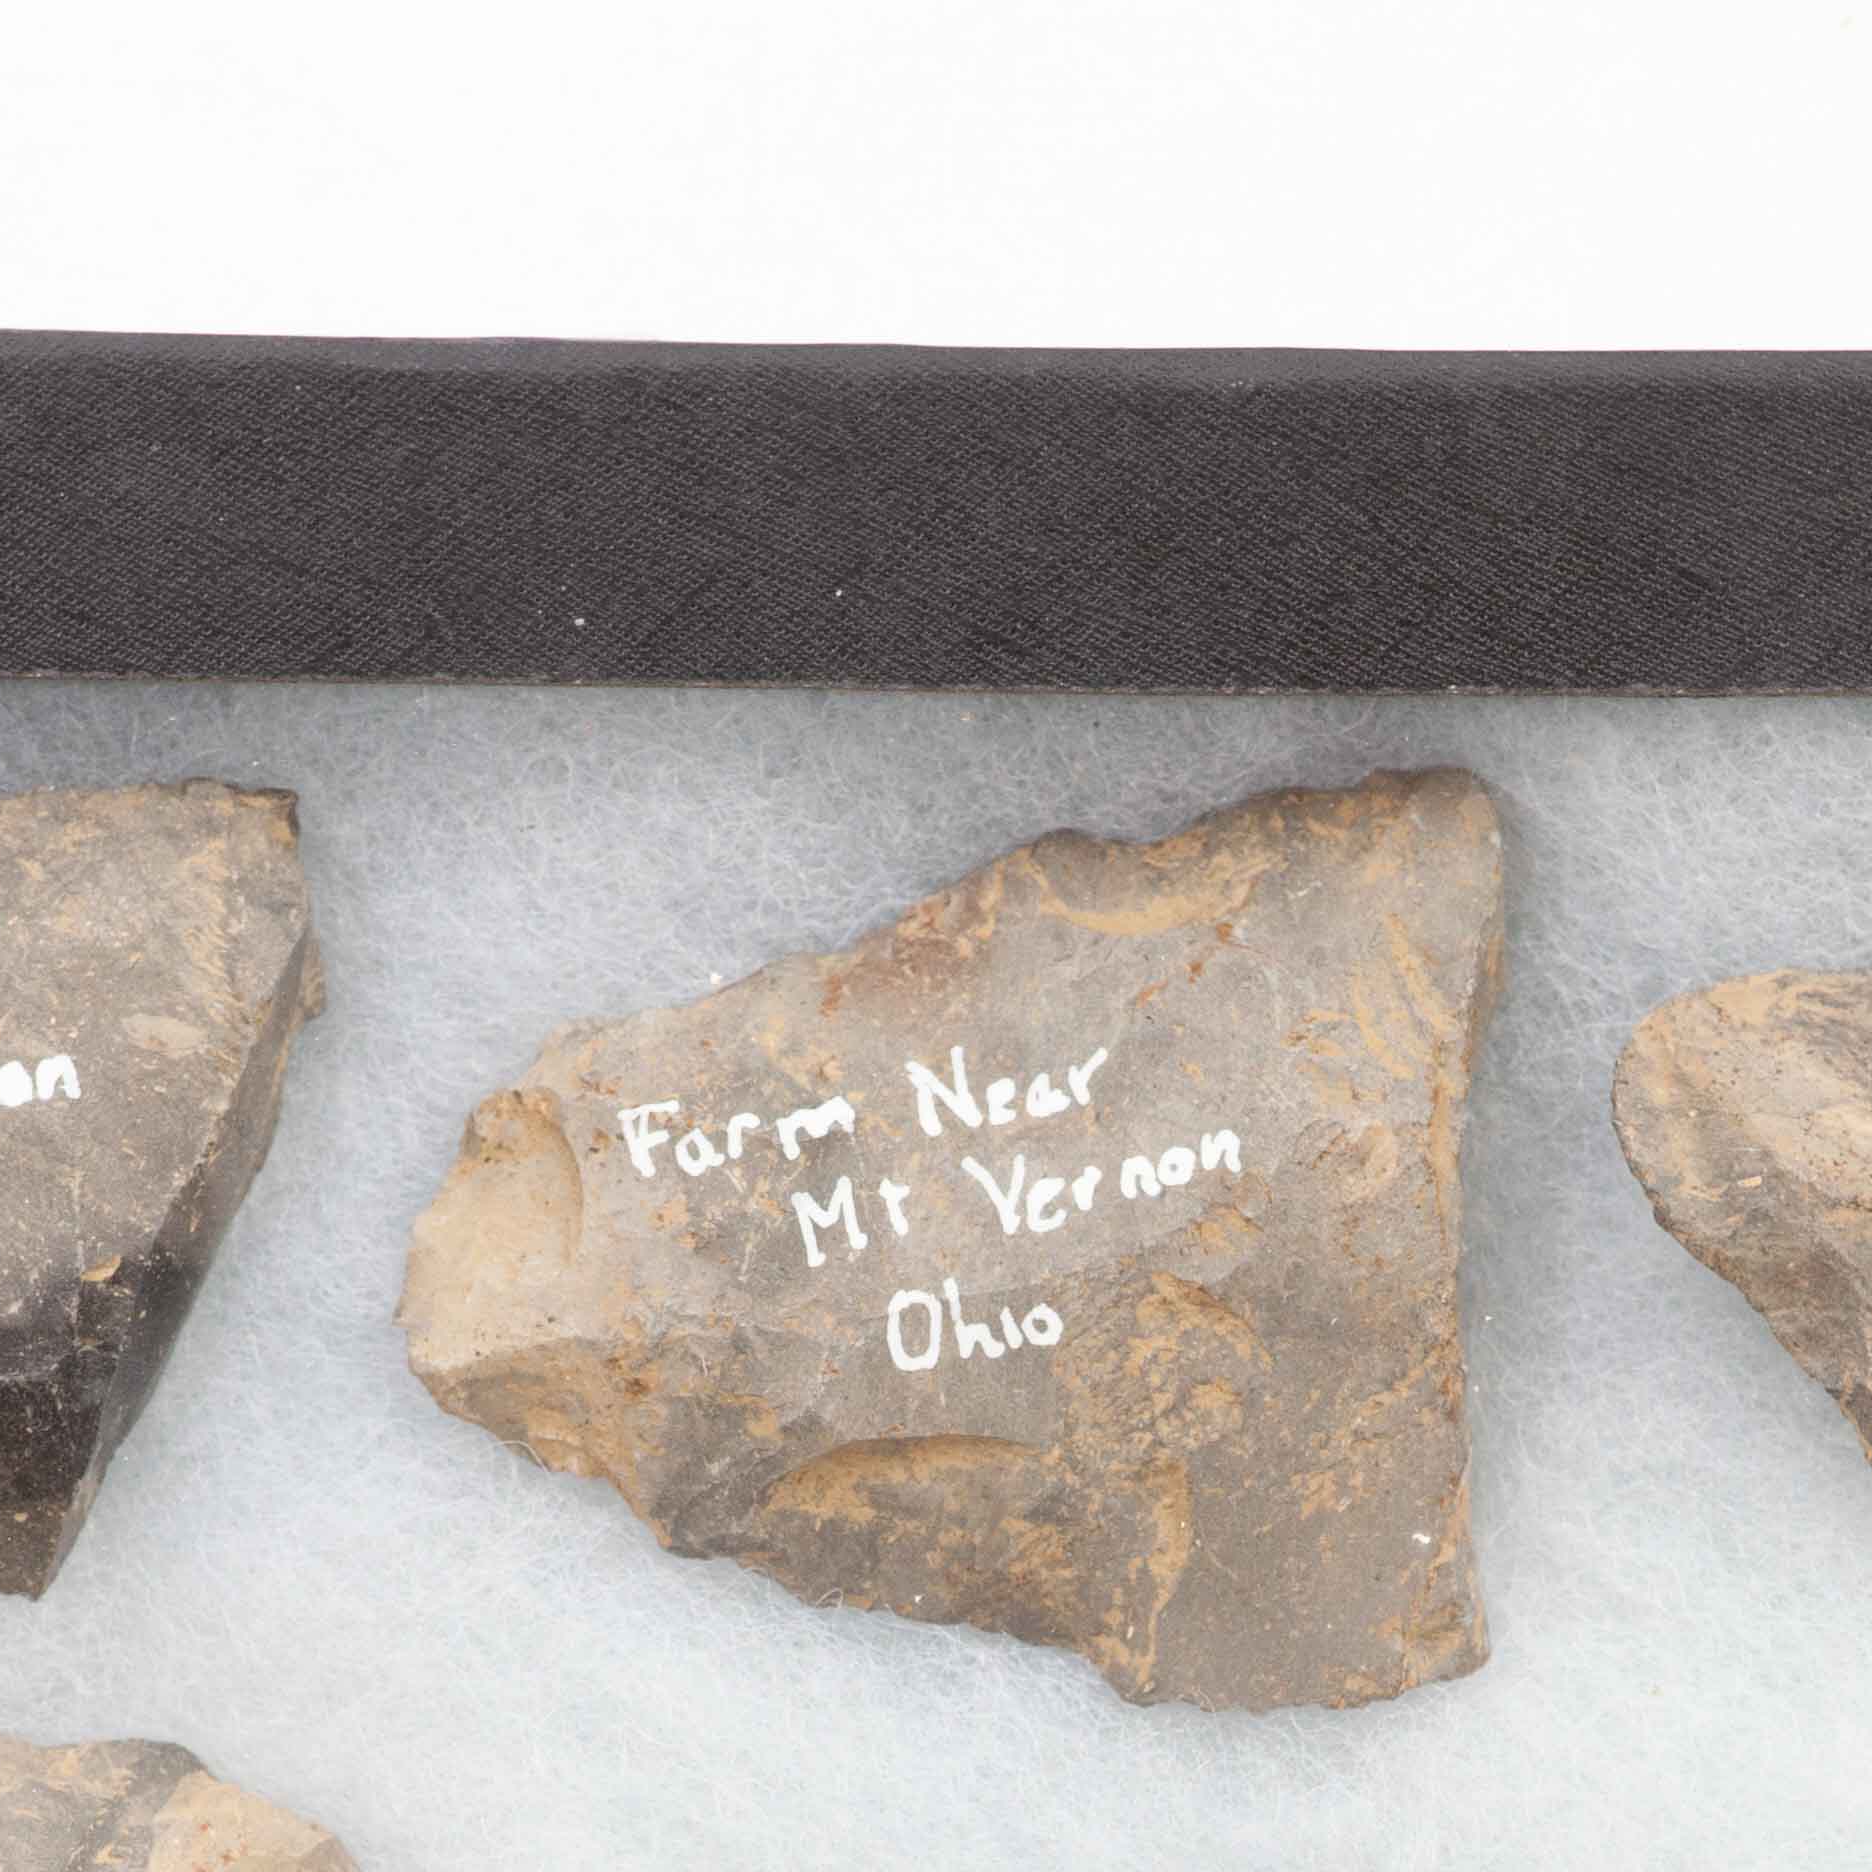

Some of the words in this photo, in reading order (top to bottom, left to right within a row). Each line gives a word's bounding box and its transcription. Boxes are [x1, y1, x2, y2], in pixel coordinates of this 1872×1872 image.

[617, 1096, 856, 1177] Farm
[904, 1045, 1108, 1136] Near
[790, 1176, 910, 1267] Mt
[961, 1128, 1241, 1236] Vernon
[886, 1277, 1064, 1372] Ohio
